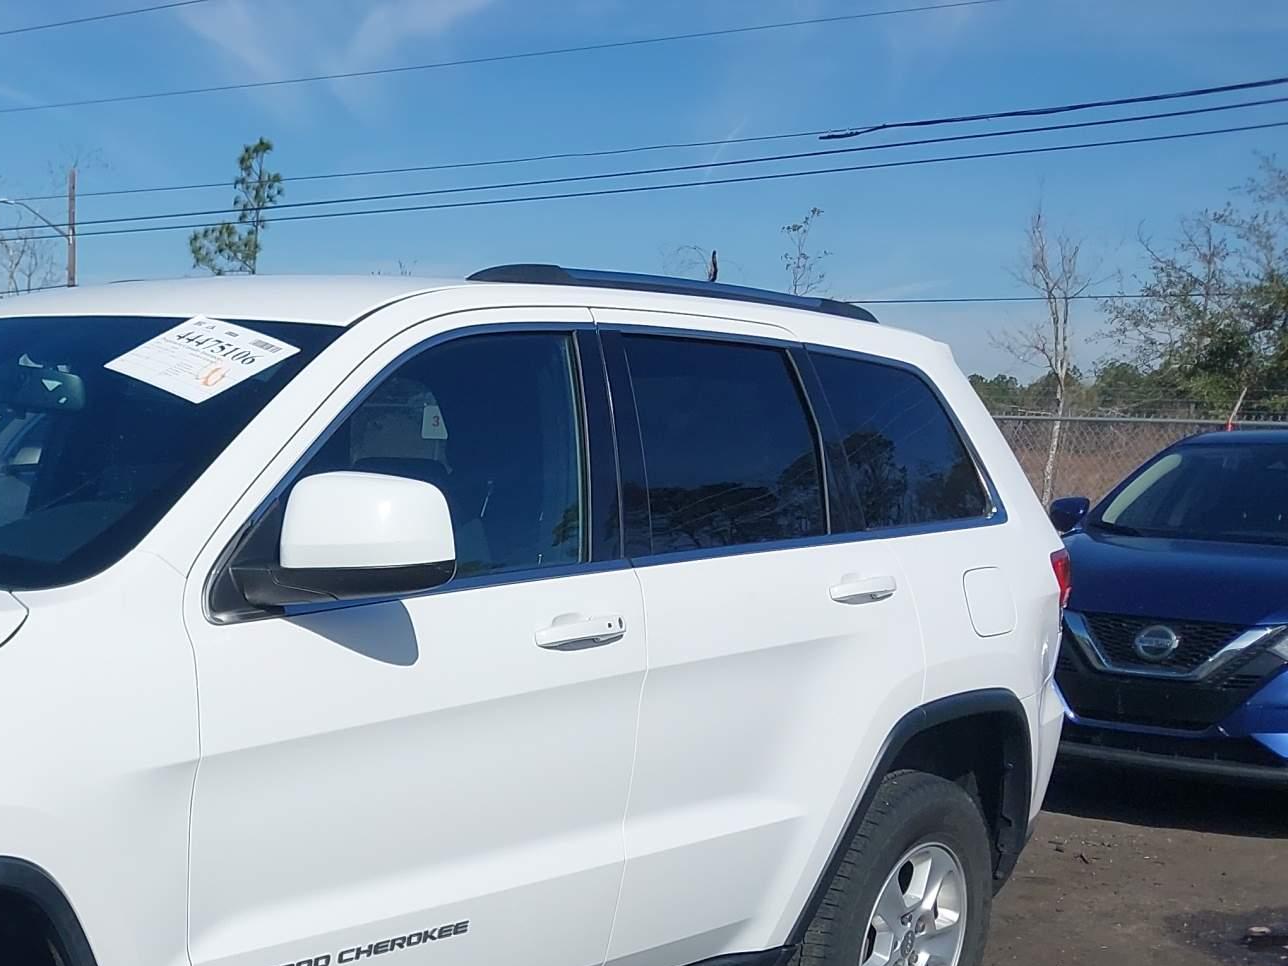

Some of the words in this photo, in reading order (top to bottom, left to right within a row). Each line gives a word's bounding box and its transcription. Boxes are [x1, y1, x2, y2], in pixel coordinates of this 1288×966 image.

[176, 331, 260, 365] 44475106
[431, 415, 440, 428] 3
[337, 920, 470, 965] CHEROKEE
